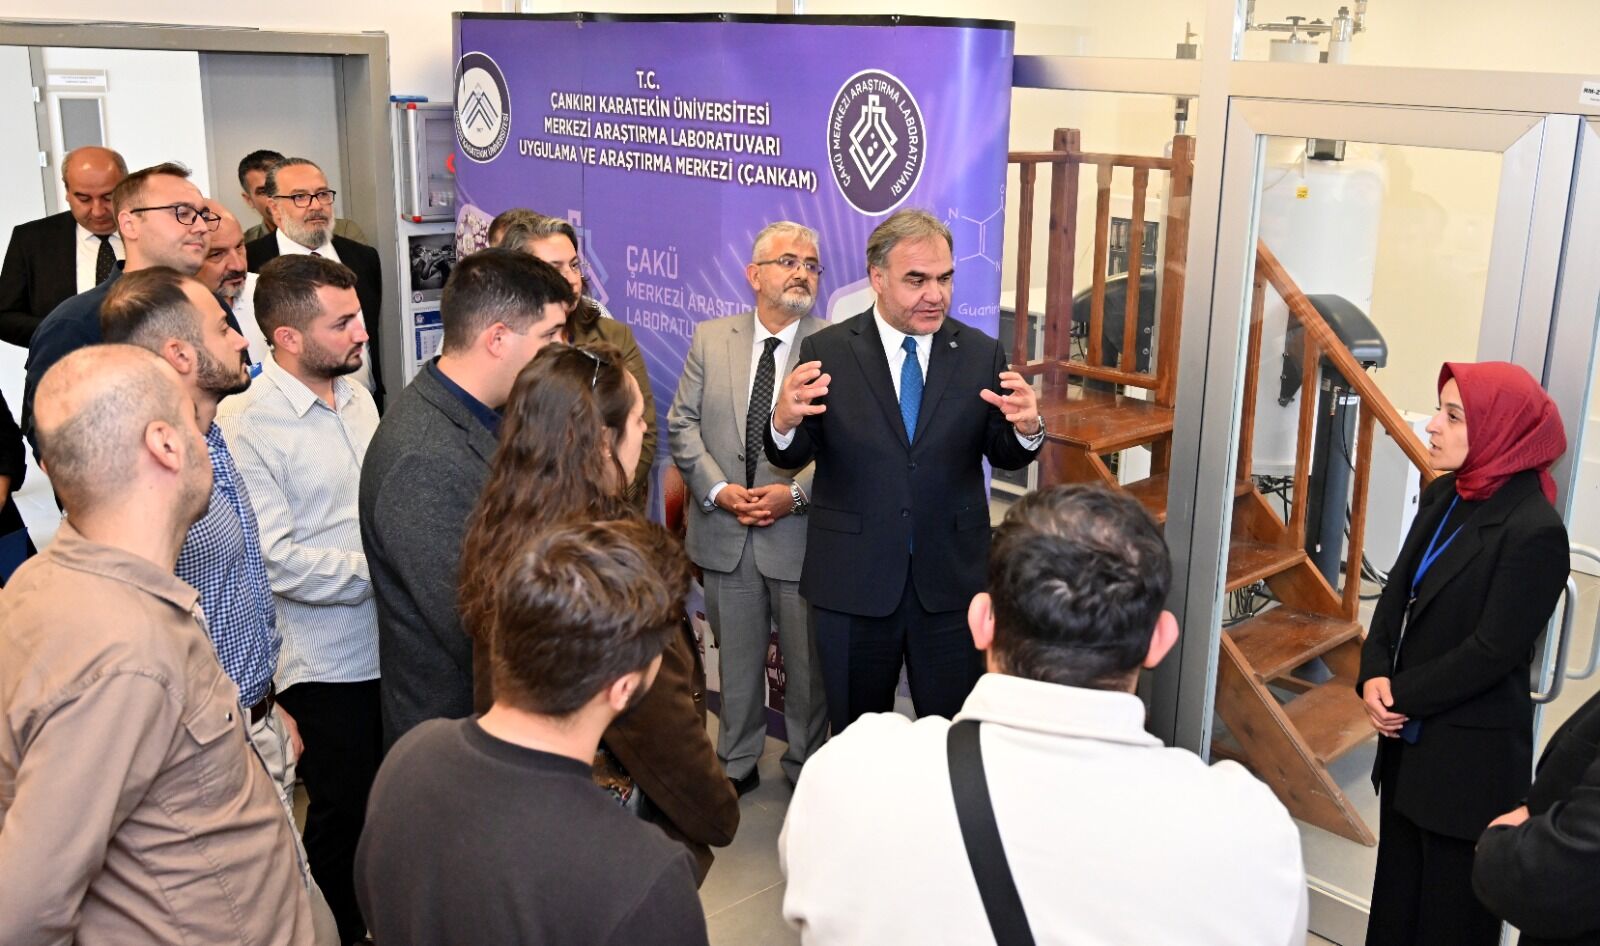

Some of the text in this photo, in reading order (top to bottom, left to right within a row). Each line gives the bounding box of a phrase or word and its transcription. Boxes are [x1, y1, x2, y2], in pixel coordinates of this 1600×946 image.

[636, 70, 660, 89] T.C.
[550, 92, 770, 126] ÇANKIRI KARATEKİN ÜNİVERSİTESİ
[544, 116, 781, 157] MERKEZİ ARAŞTIRMA LABORATUVARI
[833, 79, 918, 197] ÇAKÜ MERKEZİ ARAŞTIRMA LABORATUVARI
[519, 139, 818, 193] UYGULAMA VE ARAŞTIRMA MERKEZİ (ÇANKAM)
[948, 208, 959, 220] N
[626, 244, 679, 280] ÇAKÜ
[626, 279, 684, 309] MERKEZİ
[626, 306, 698, 339] LABORATU
